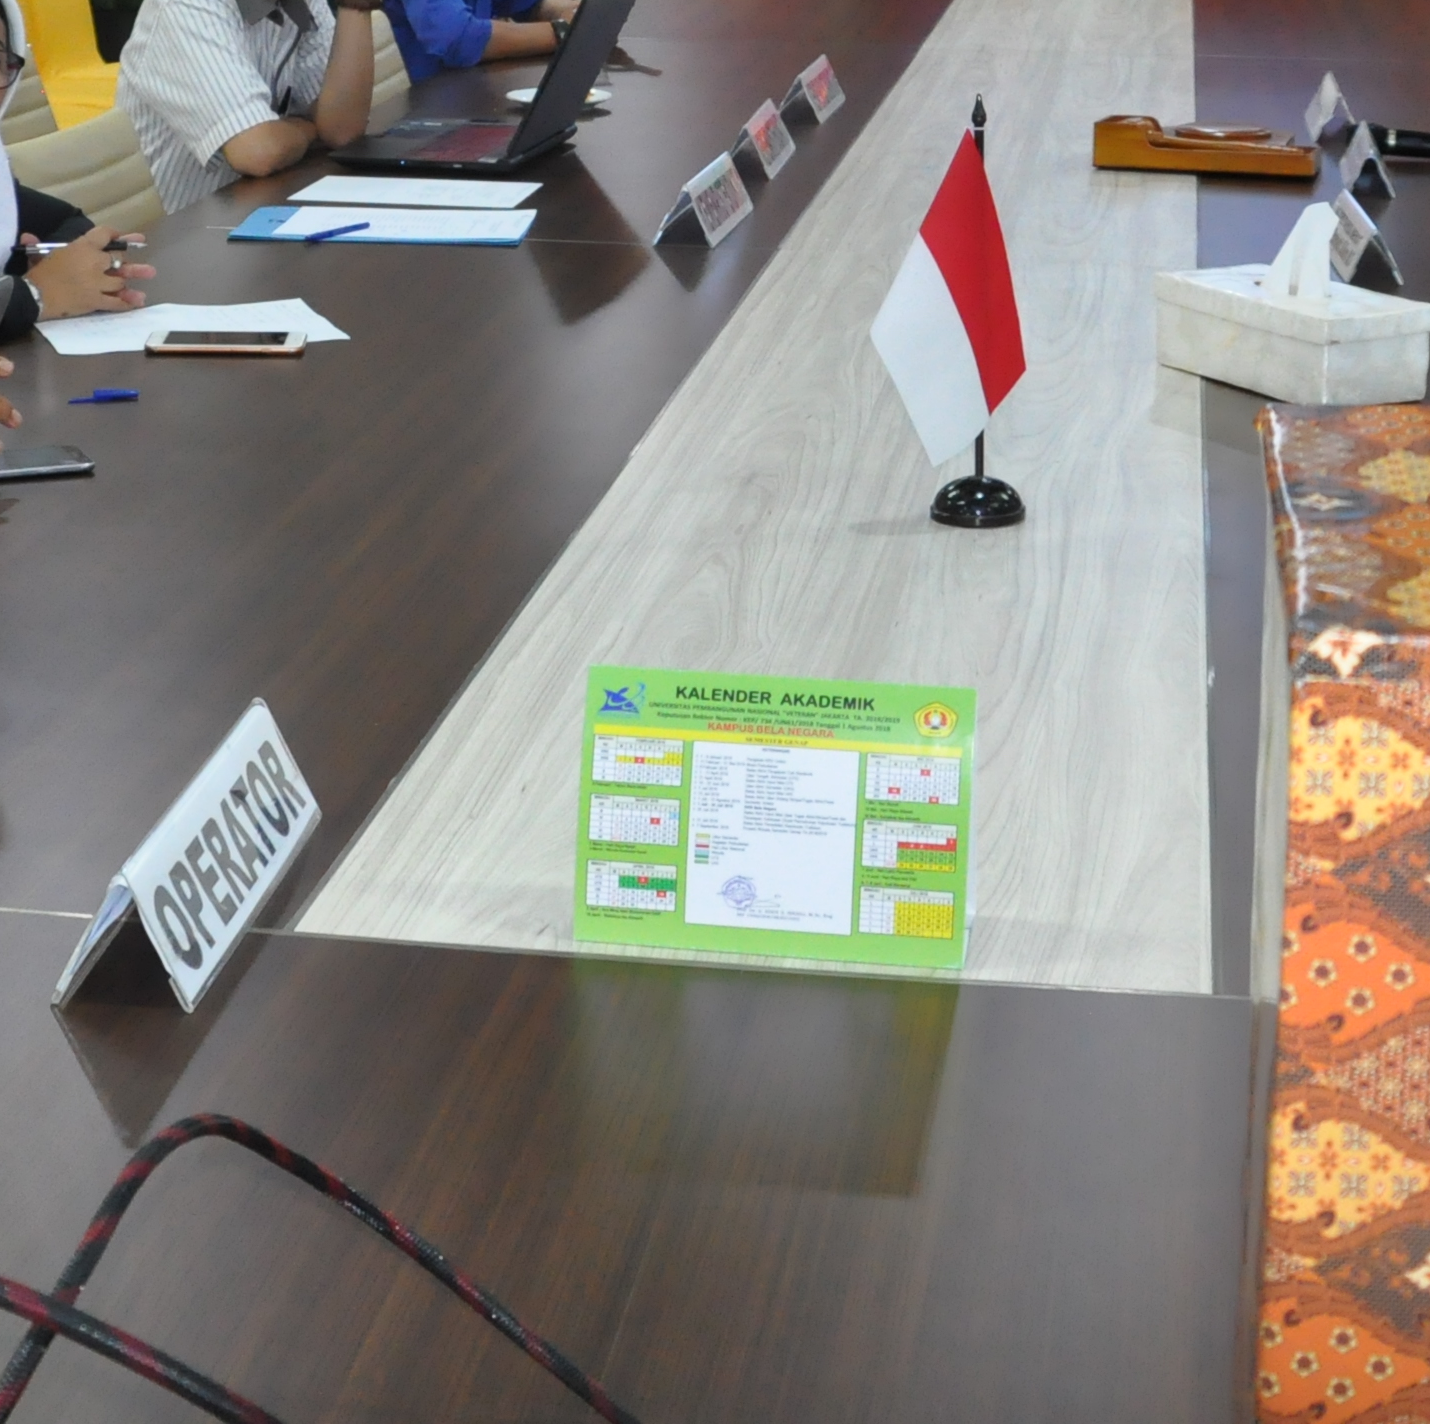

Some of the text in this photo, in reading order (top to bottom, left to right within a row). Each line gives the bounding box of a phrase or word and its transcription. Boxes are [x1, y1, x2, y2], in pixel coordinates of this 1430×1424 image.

[676, 685, 875, 712] KALENDER AKADEMIK
[649, 701, 691, 711] UNIVERSITAS
[821, 713, 850, 721] JAKARTA
[707, 722, 835, 739] KAMPUS BELA NEGARA
[154, 740, 306, 970] OPERATOR
